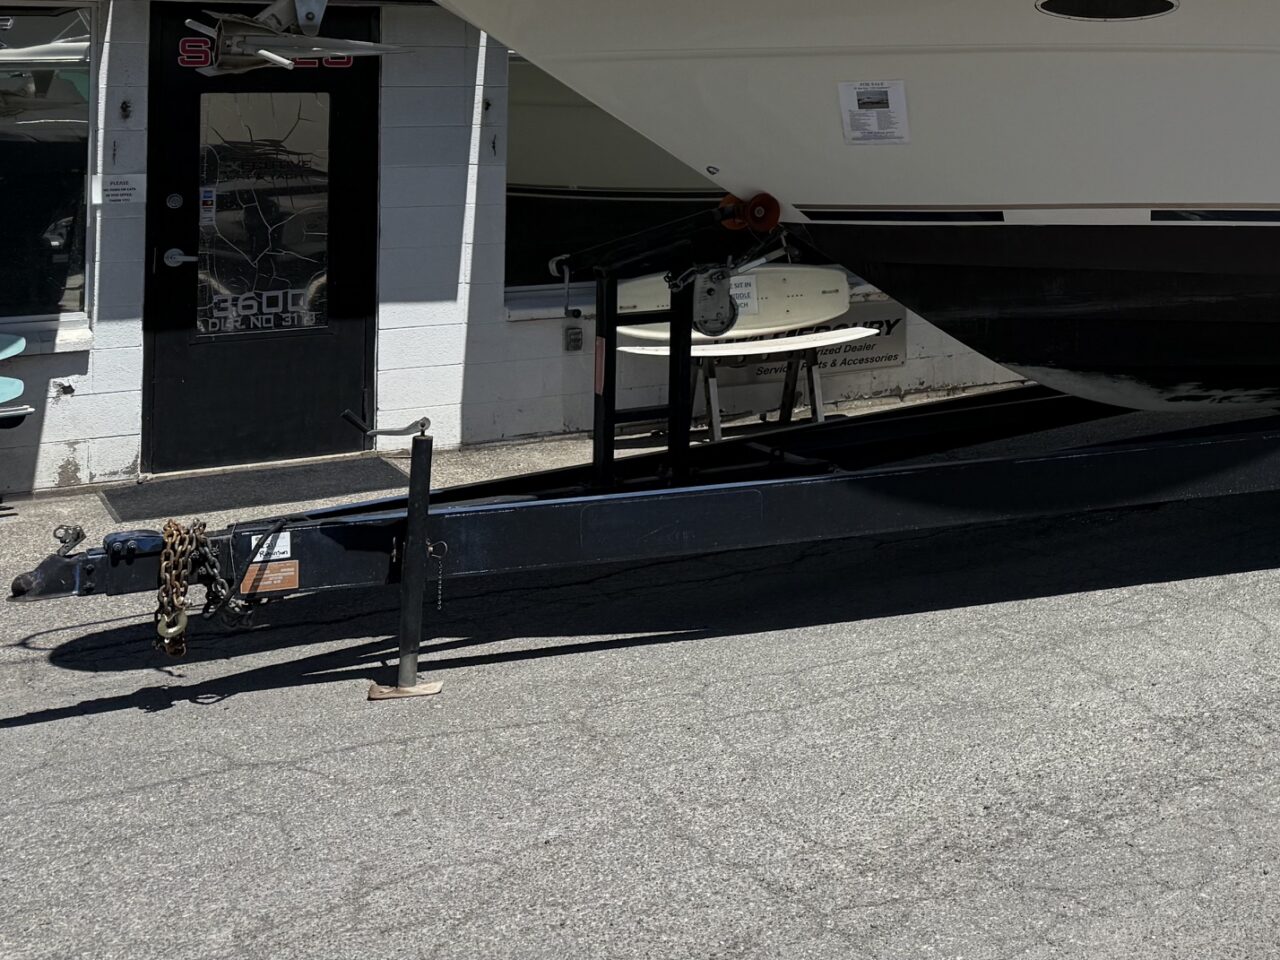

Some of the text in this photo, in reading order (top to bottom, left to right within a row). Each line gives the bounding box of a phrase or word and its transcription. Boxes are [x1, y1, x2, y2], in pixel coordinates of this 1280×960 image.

[744, 280, 752, 288] IN
[213, 289, 309, 317] 3600
[843, 343, 877, 353] Dealer
[756, 353, 899, 376] Servic Pts & Accessories
